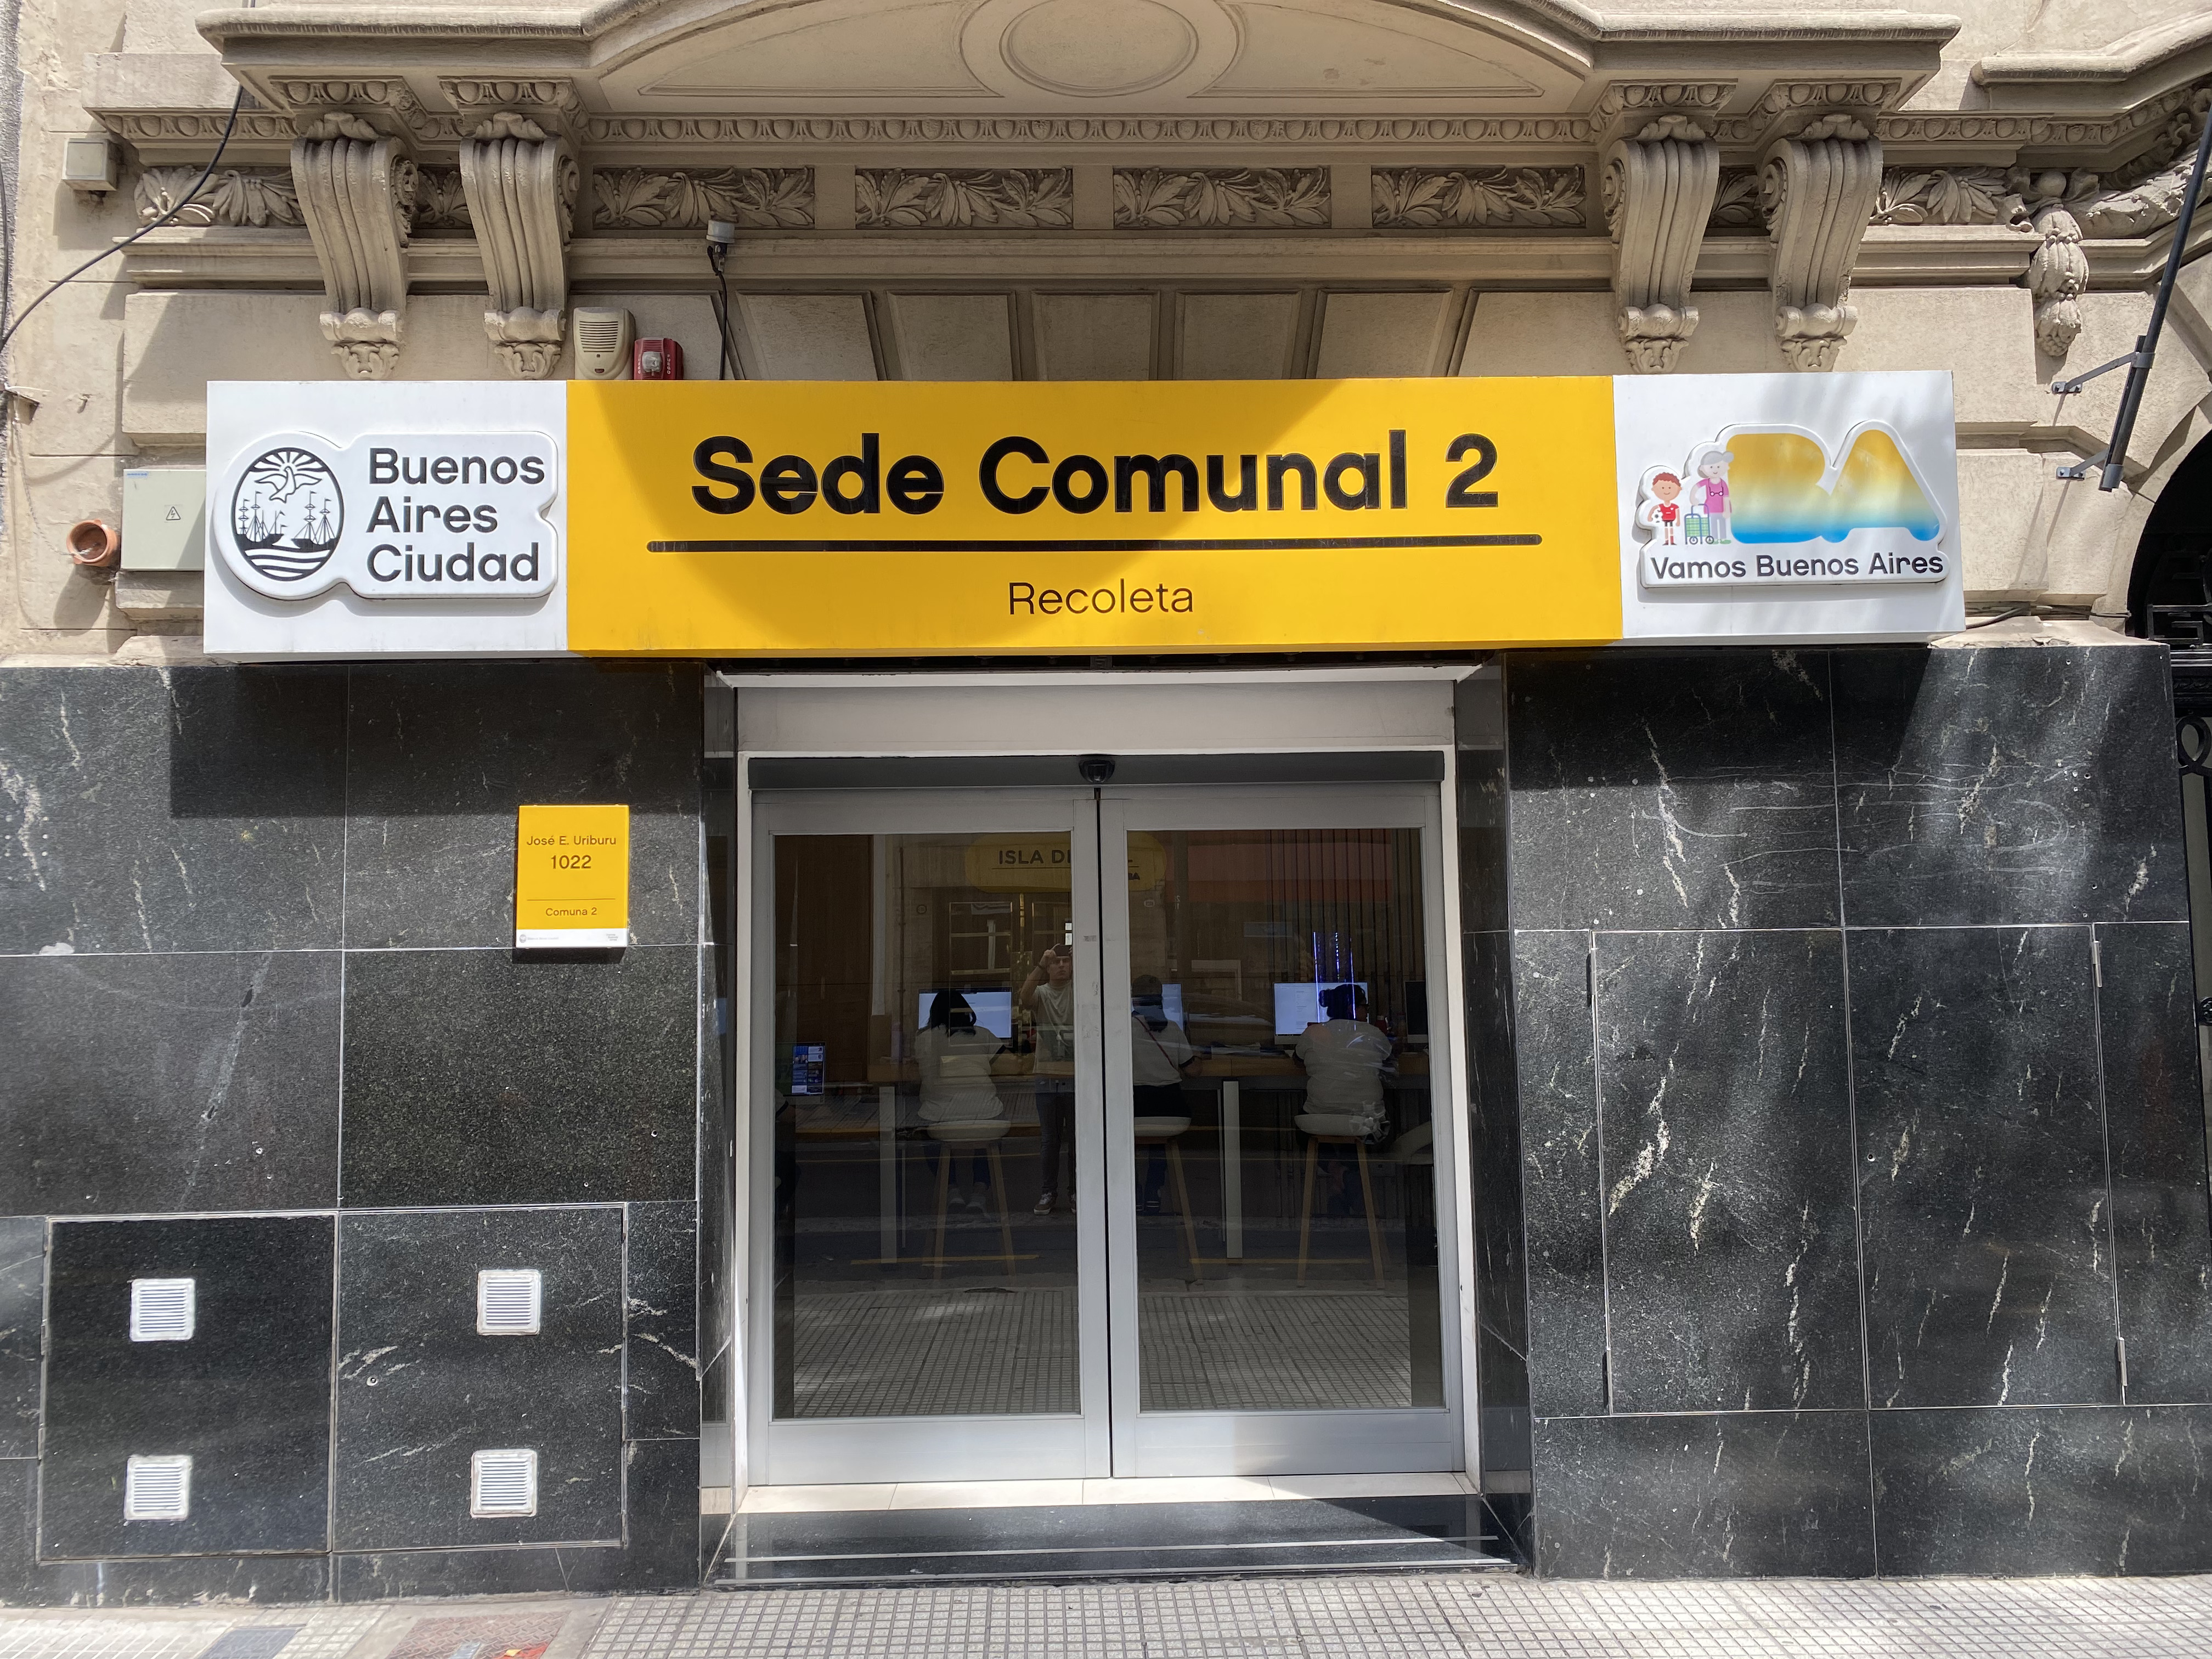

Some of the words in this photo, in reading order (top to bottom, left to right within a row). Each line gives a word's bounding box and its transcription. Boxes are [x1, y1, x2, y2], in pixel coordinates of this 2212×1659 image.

[369, 448, 545, 484] Buenos
[691, 432, 945, 515] Sede
[979, 430, 1406, 515] Comunal
[1446, 434, 1499, 507] 2
[366, 496, 498, 533] Aires
[367, 542, 539, 582] Ciudad
[1651, 557, 1746, 579] Vamos
[1756, 555, 1859, 577] Buenos
[1869, 552, 1944, 574] Aires
[1009, 579, 1193, 615] Recoleta
[526, 836, 555, 845] José
[559, 836, 569, 845] E.
[573, 835, 617, 845] Uriburu
[551, 854, 592, 870] 1022
[999, 850, 1044, 865] ISLA
[545, 907, 588, 916] Comuna
[591, 907, 597, 916] 2
